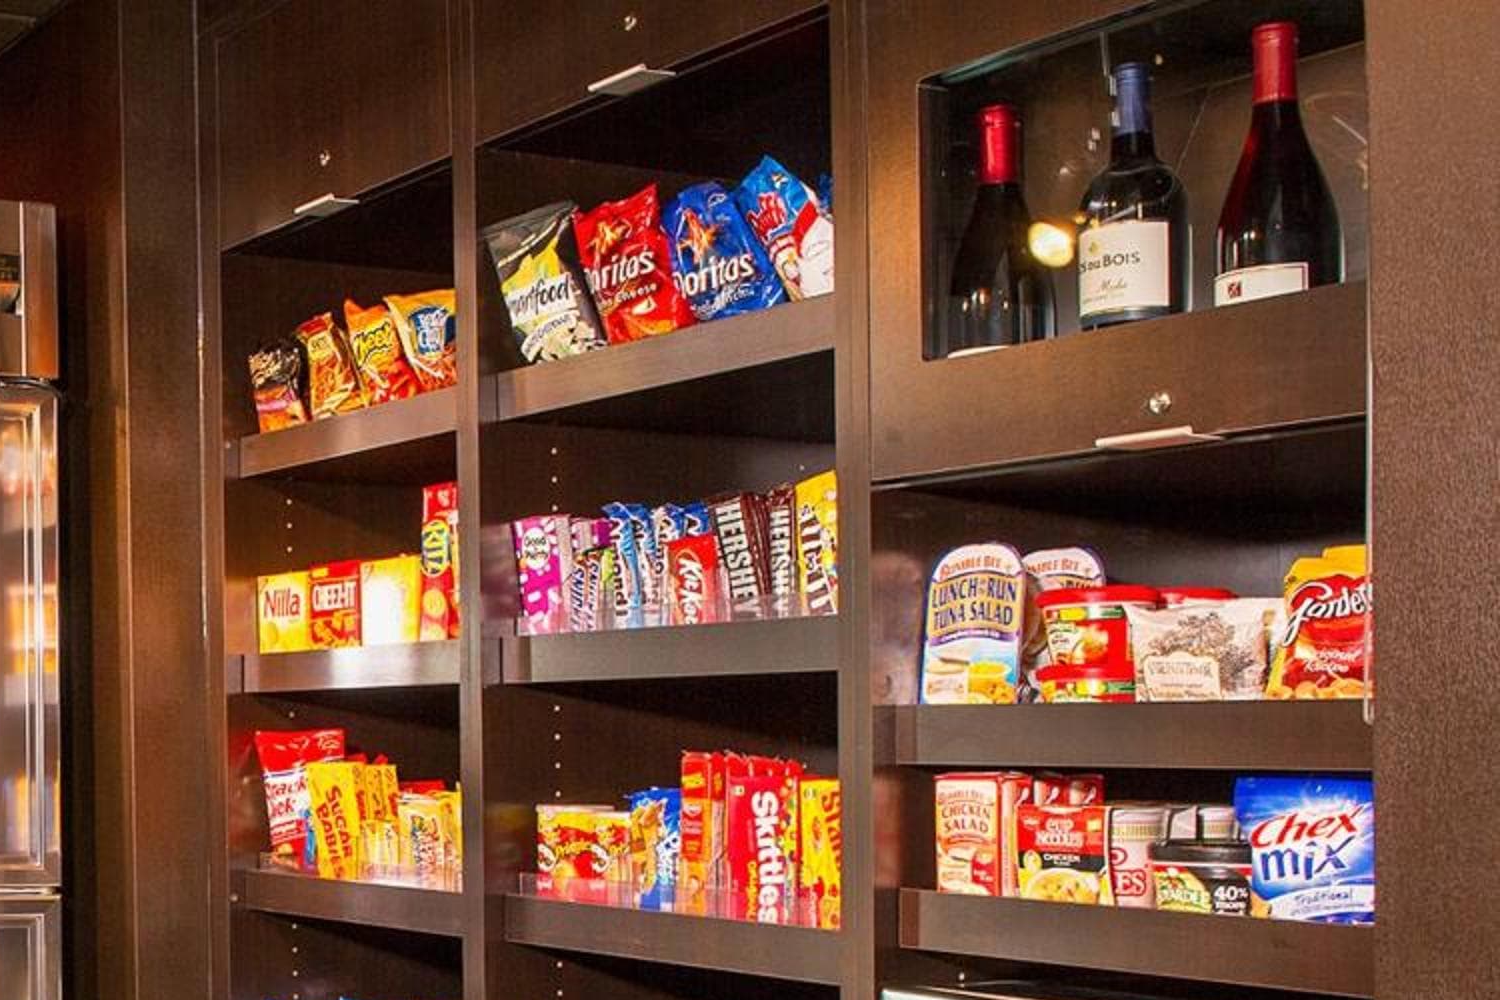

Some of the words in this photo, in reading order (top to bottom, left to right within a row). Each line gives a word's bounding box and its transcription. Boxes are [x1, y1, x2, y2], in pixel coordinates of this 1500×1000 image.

[1102, 252, 1141, 268] BOIS
[715, 499, 762, 616] HERSHEY
[263, 587, 301, 618] Nilla
[932, 576, 979, 608] LUNCH
[987, 577, 1017, 602] RUN
[934, 604, 965, 631] TUNA
[970, 601, 1014, 626] SALAD
[324, 784, 353, 858] SUGAR
[941, 806, 992, 819] CHICKEN
[944, 817, 989, 833] SALAD
[1250, 804, 1365, 849] Chex
[751, 791, 787, 924] Skittles
[1260, 834, 1356, 881] mix
[1213, 885, 1249, 901] 40%
